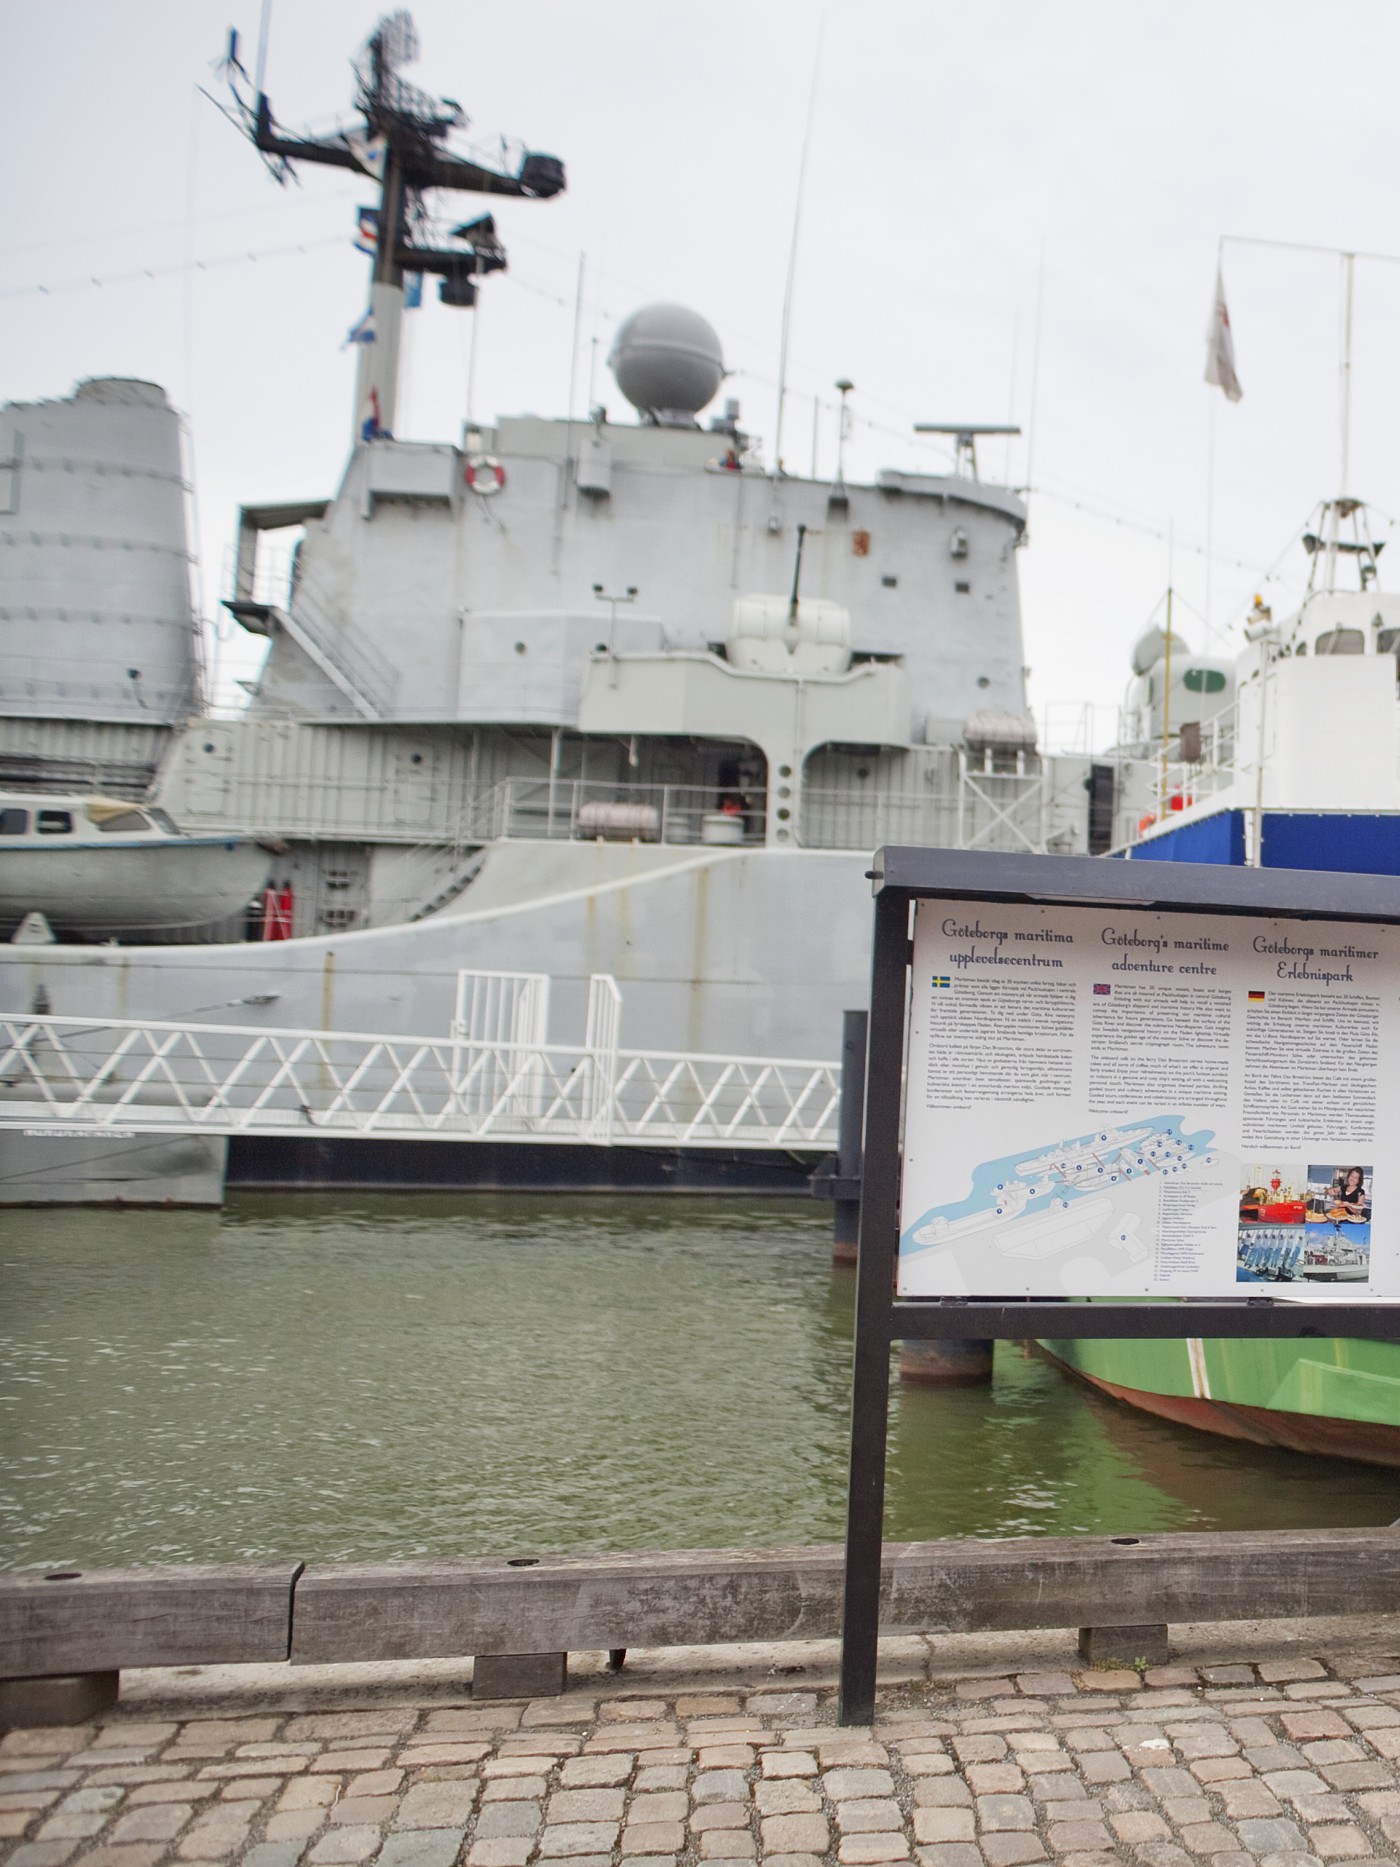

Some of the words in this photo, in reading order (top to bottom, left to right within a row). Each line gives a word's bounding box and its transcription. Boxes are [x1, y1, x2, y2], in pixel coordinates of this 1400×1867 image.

[941, 918, 1008, 944] Göteborgs
[1014, 929, 1074, 944] maritima
[1101, 928, 1168, 953] Göteborg's
[1174, 938, 1230, 952] maritime
[949, 946, 1063, 969] upplevelsecentrum
[1252, 935, 1314, 960] Göteborgs
[1320, 945, 1378, 960] maritimer
[1112, 954, 1174, 973] adventure
[1179, 962, 1217, 975] centre
[1276, 962, 1353, 986] Erlebnispark
